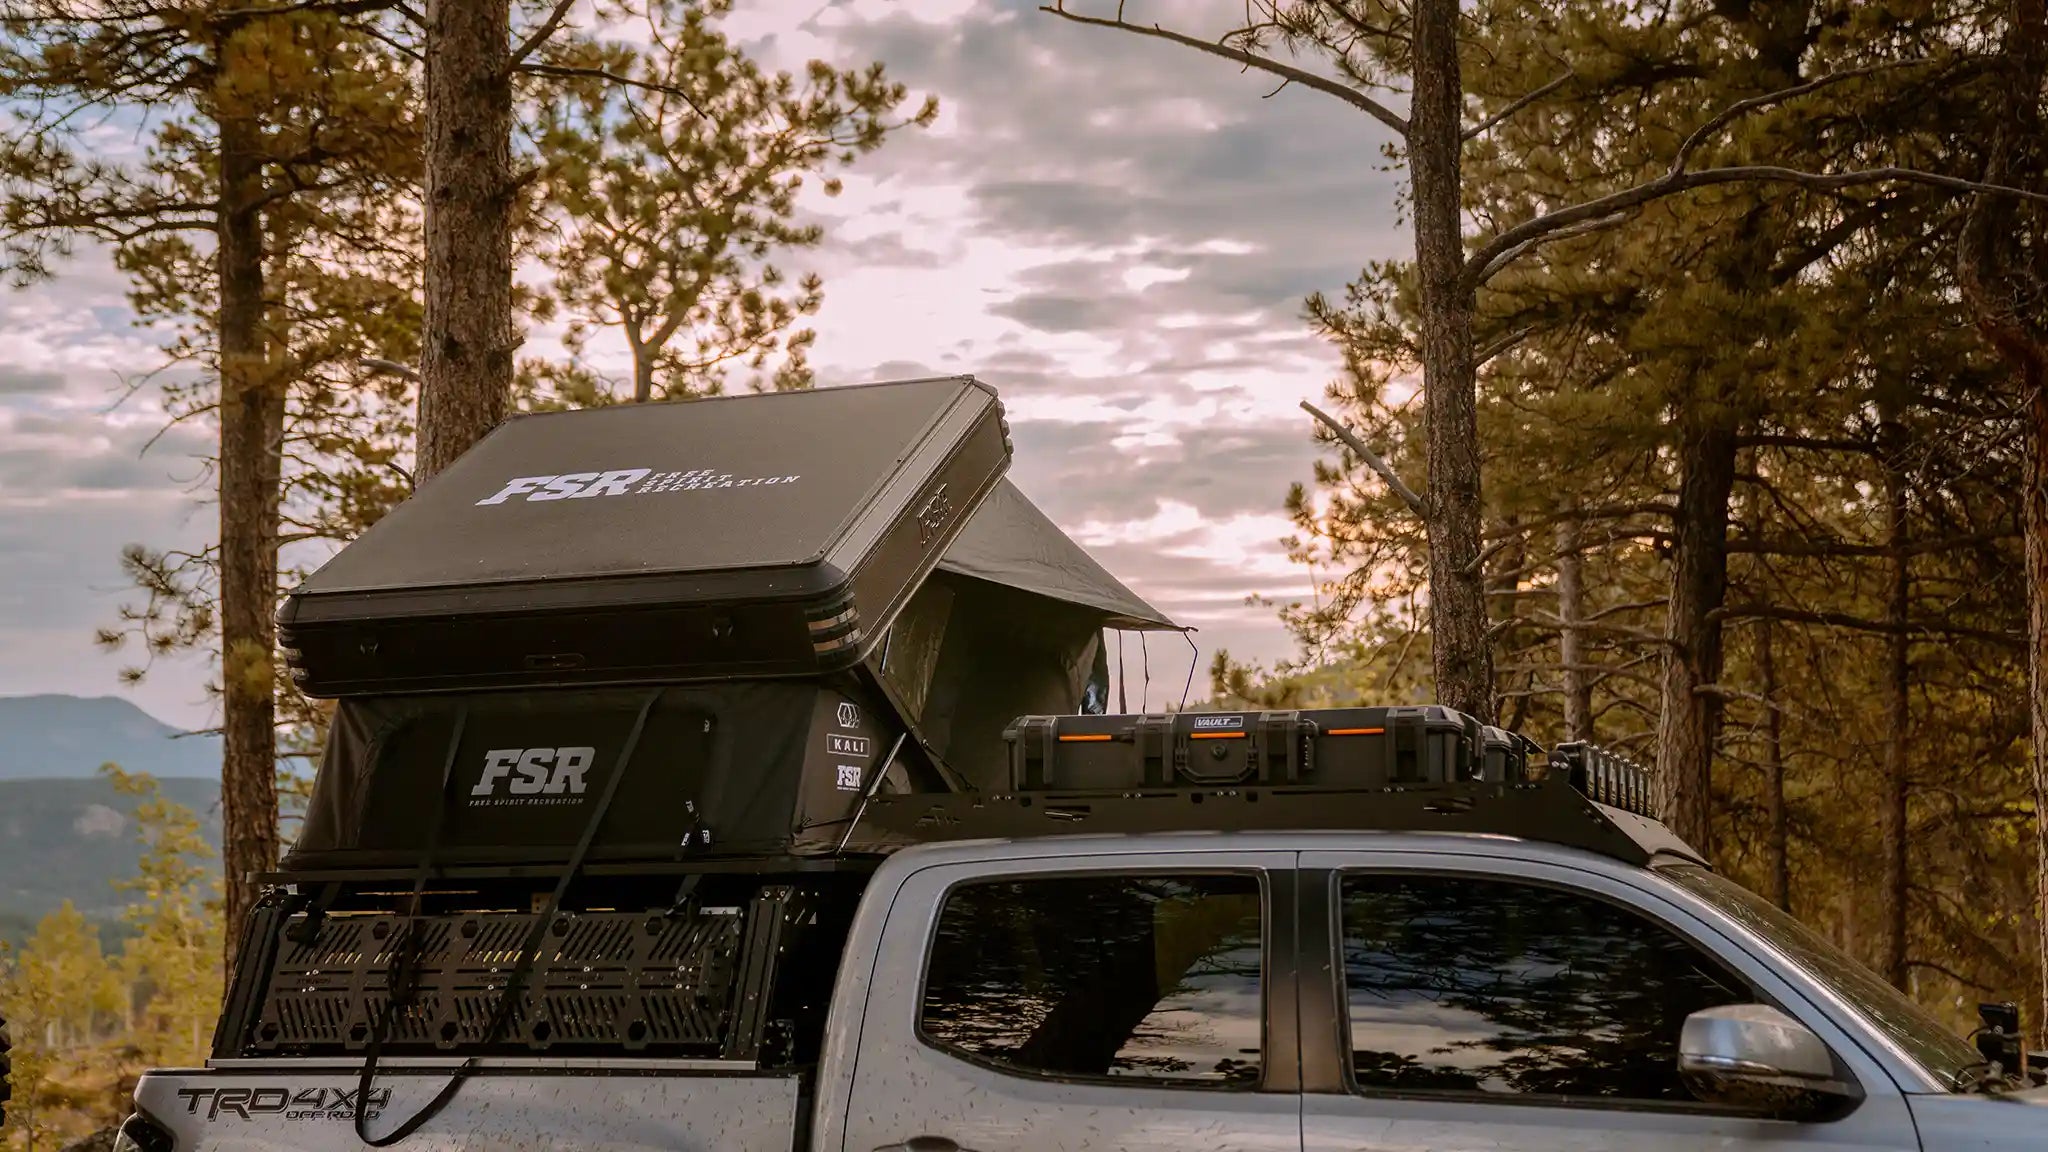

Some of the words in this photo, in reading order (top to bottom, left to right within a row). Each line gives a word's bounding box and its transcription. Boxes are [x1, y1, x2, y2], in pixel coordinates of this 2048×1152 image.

[643, 474, 732, 487] SPIRIT
[651, 469, 714, 480] FREE
[475, 468, 651, 505] FSR
[635, 475, 800, 494] RECREATION
[1197, 718, 1231, 726] VAULT
[834, 738, 864, 753] KALI
[471, 746, 596, 796] FSR
[837, 765, 861, 788] FSR
[178, 1088, 291, 1122] TRD
[286, 1110, 325, 1121] OFF
[327, 1110, 380, 1121] ROD
